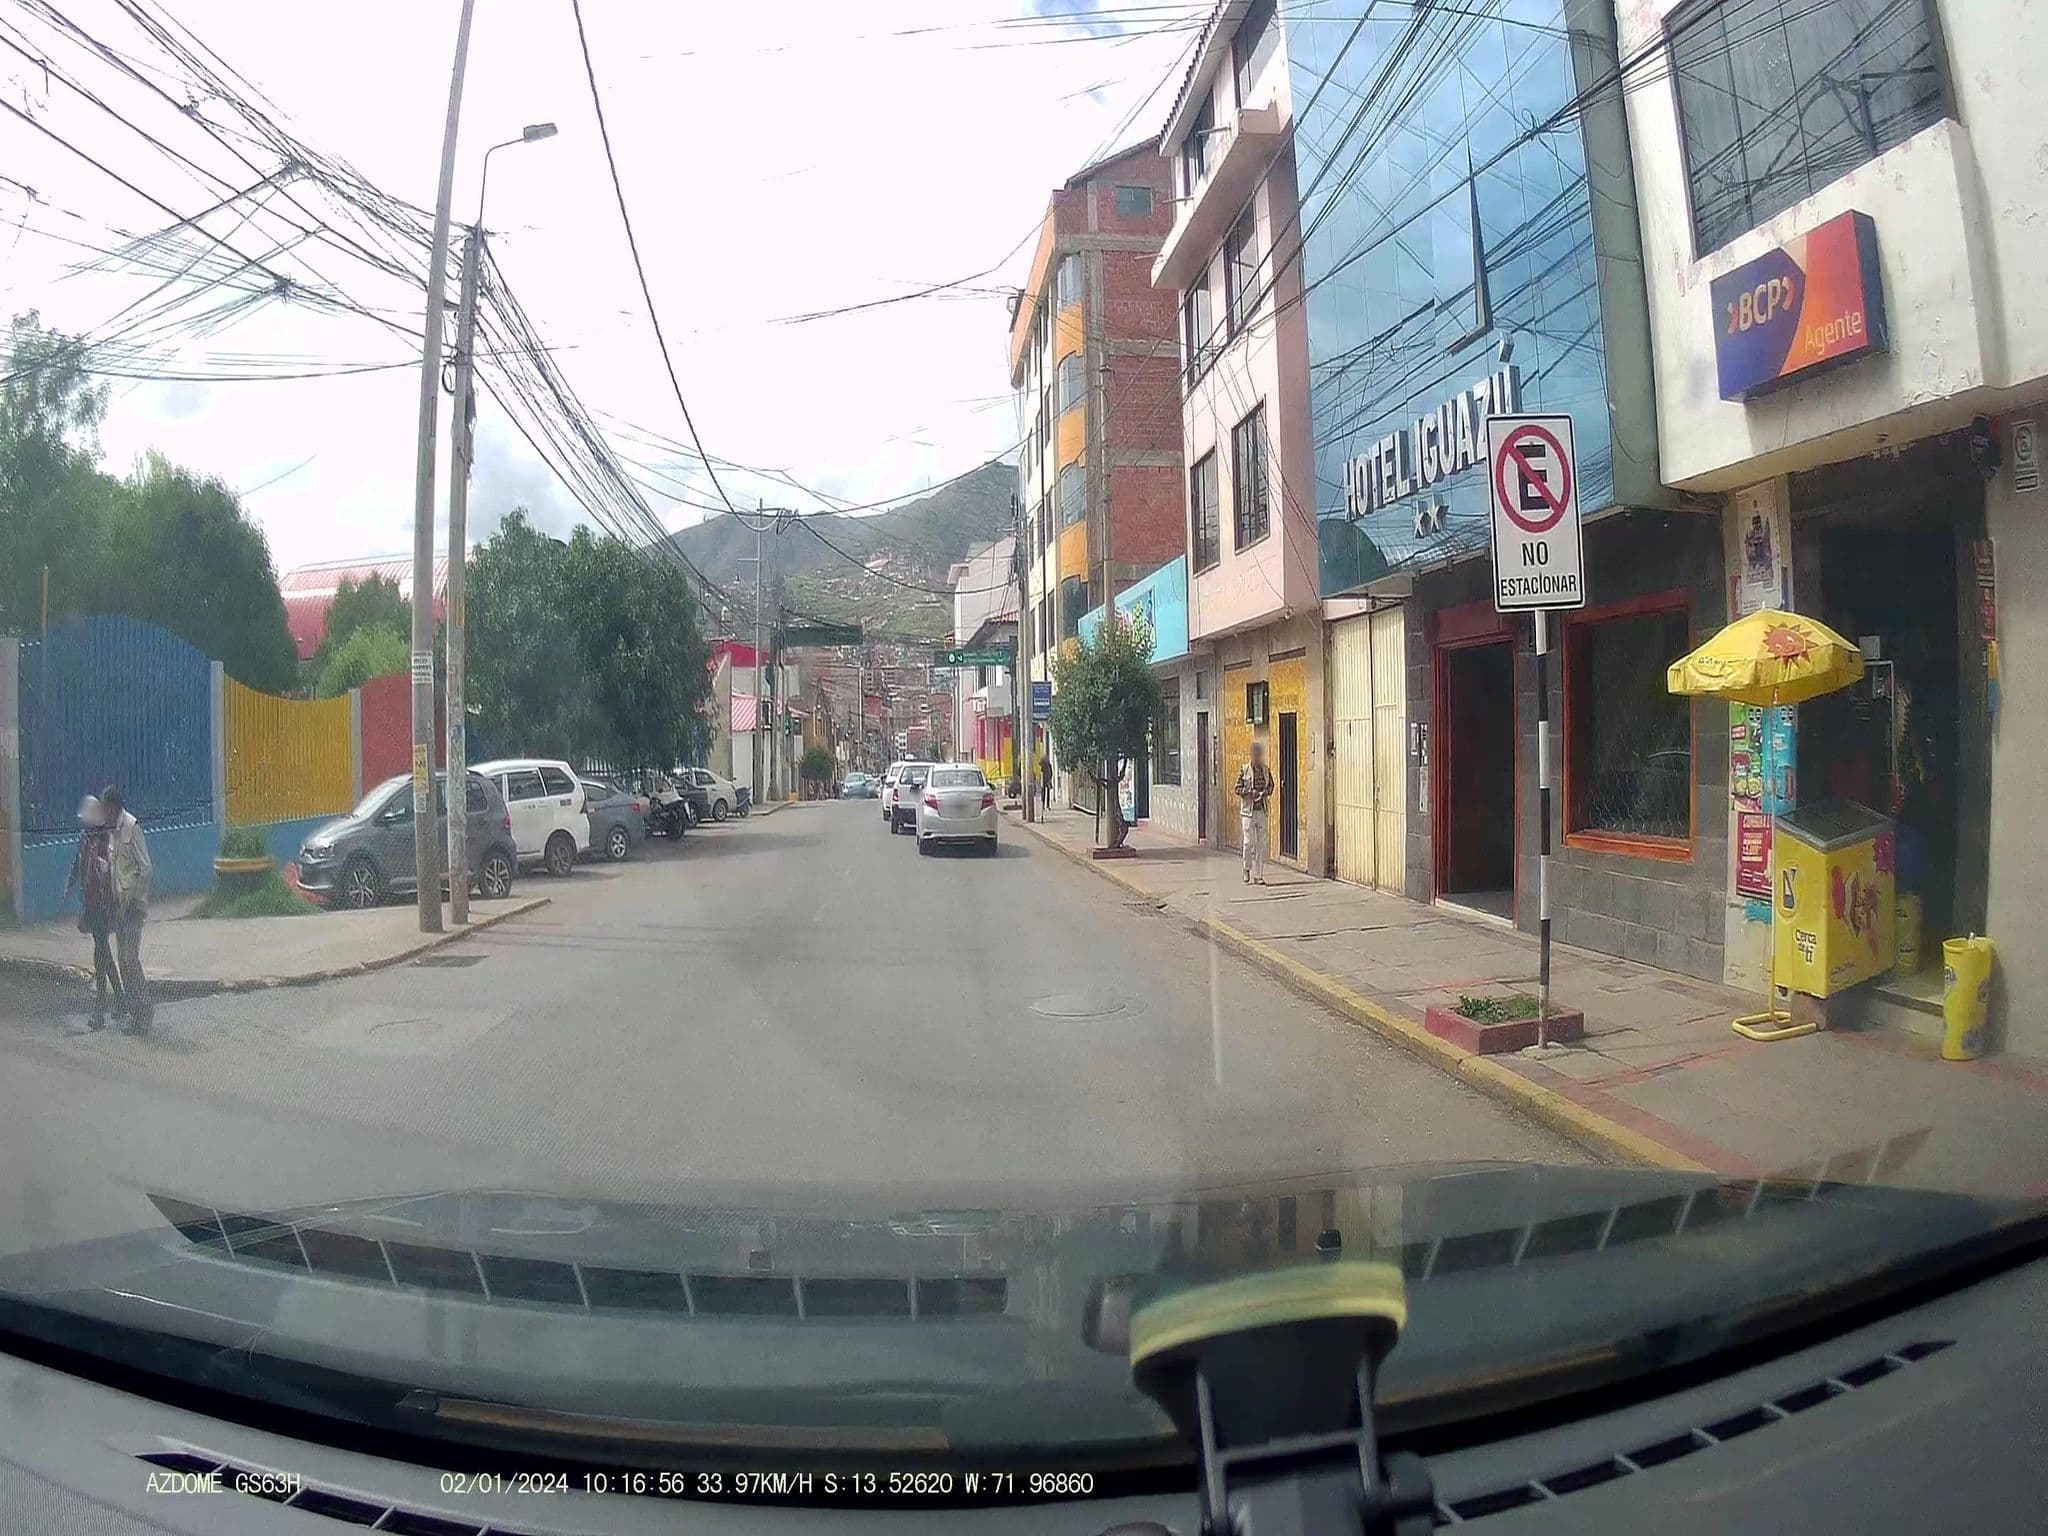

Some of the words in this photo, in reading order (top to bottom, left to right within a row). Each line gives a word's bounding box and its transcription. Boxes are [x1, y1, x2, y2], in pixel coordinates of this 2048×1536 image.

[1739, 278, 1781, 332] BCP
[1803, 310, 1862, 356] Agente
[1343, 430, 1412, 523] HOTEL
[1521, 541, 1549, 567] NO
